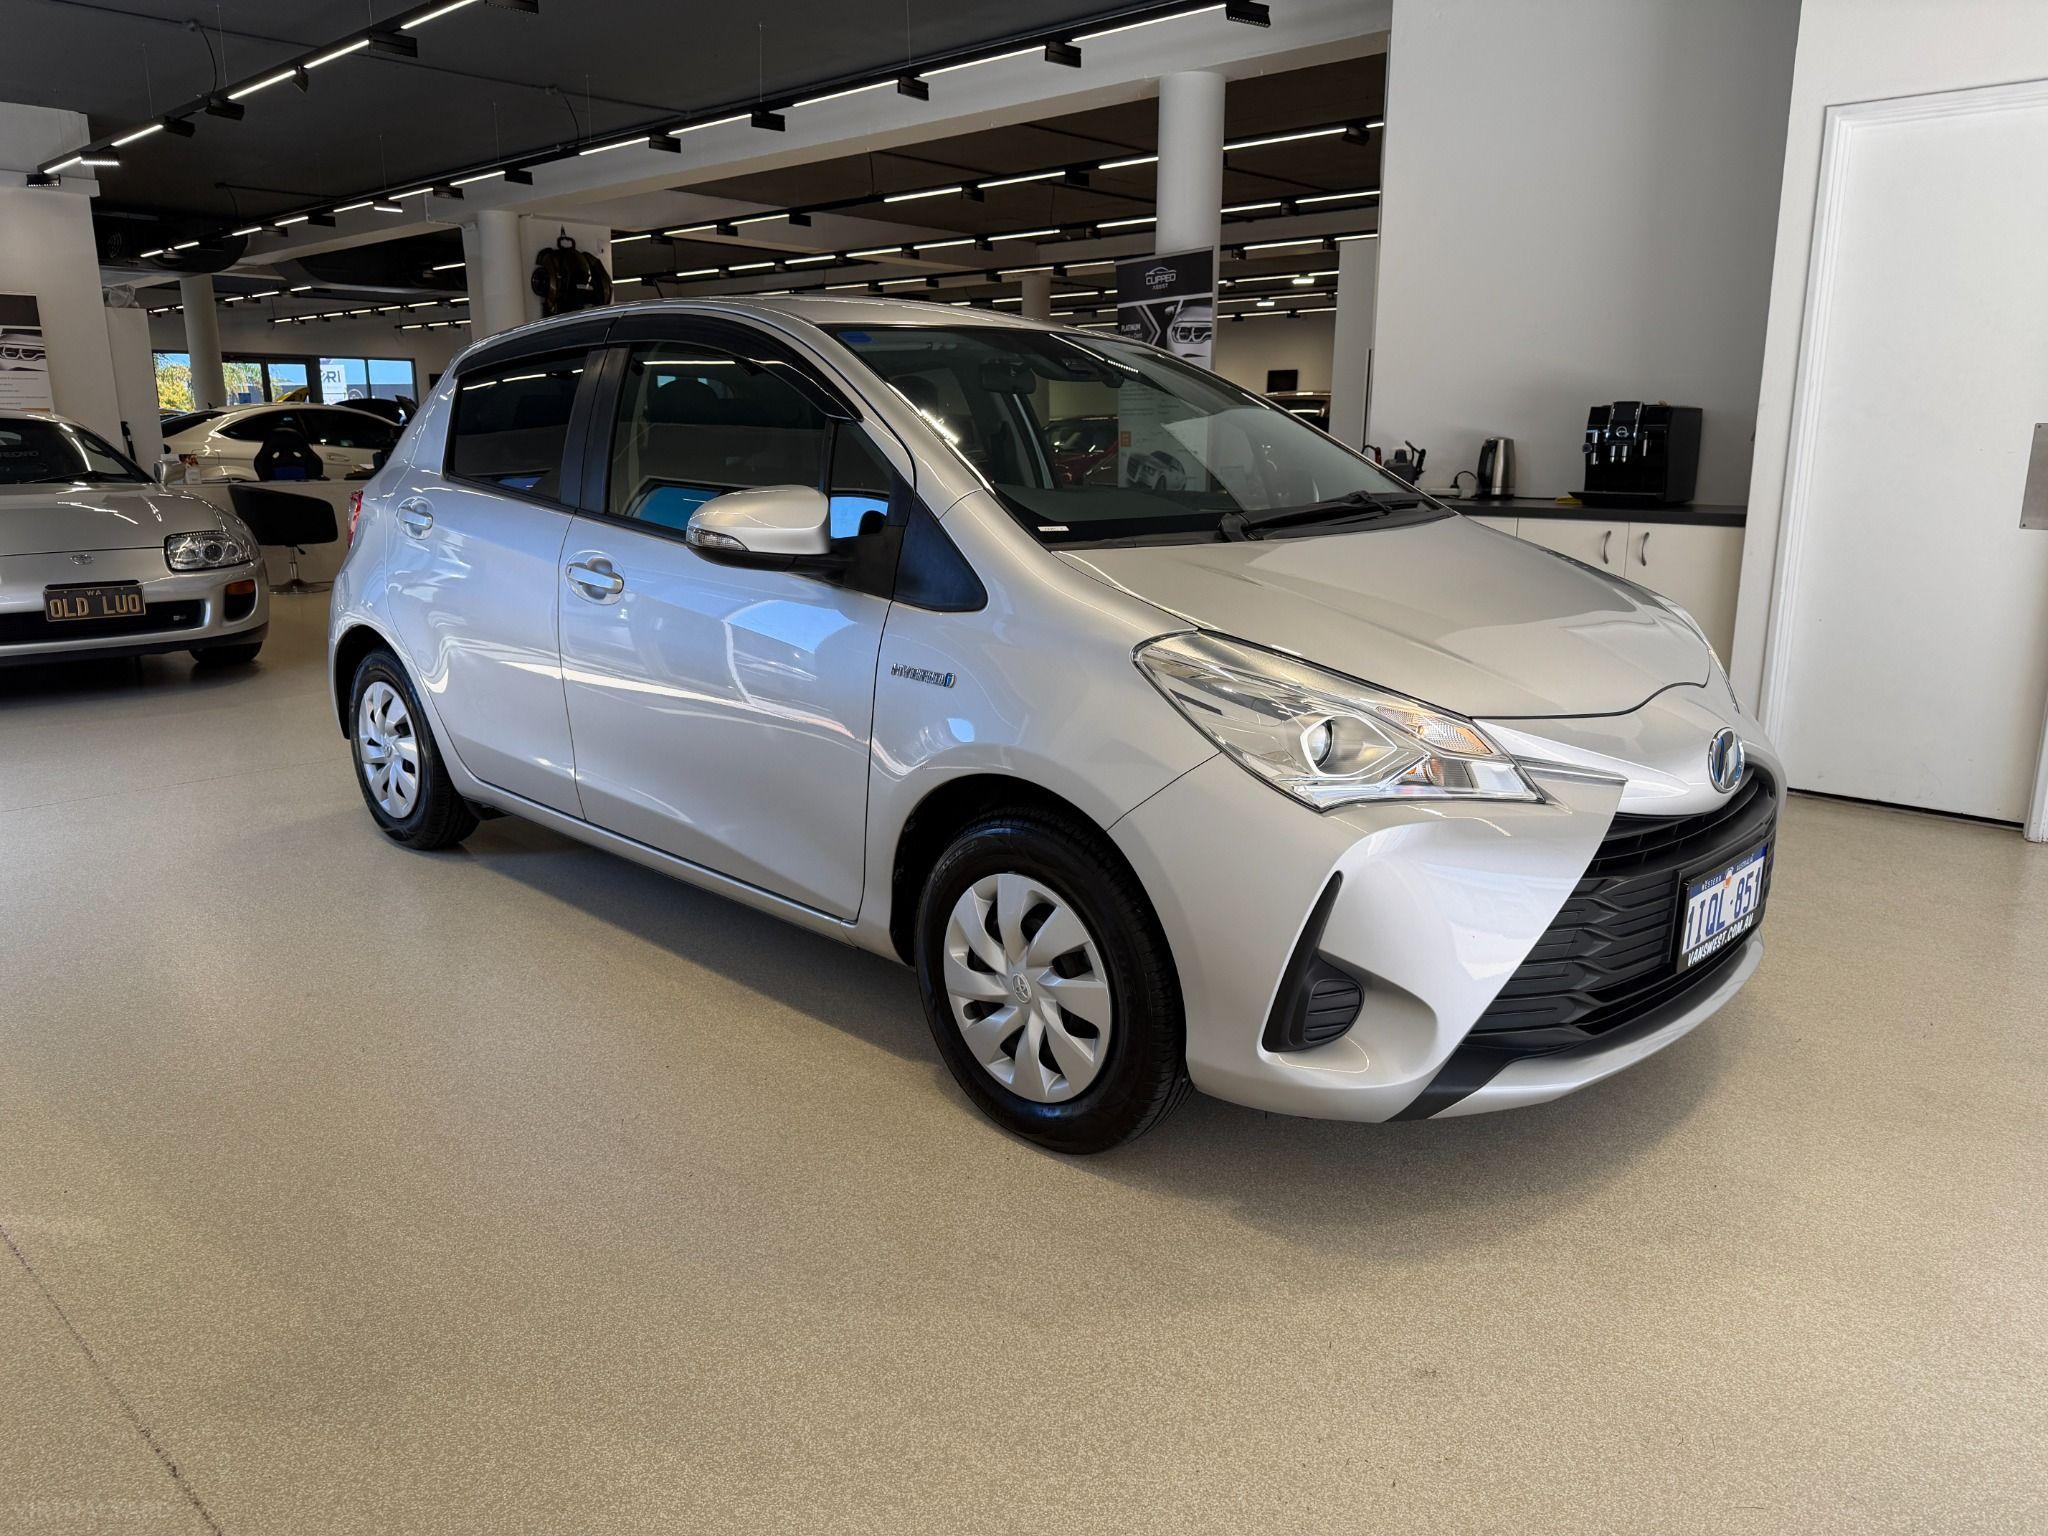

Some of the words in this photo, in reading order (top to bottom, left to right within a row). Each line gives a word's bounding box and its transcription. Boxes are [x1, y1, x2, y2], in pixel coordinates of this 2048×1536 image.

[1145, 273, 1177, 286] CLIPPED
[86, 589, 102, 597] WA
[49, 597, 90, 618] OLD
[102, 593, 141, 615] LUO
